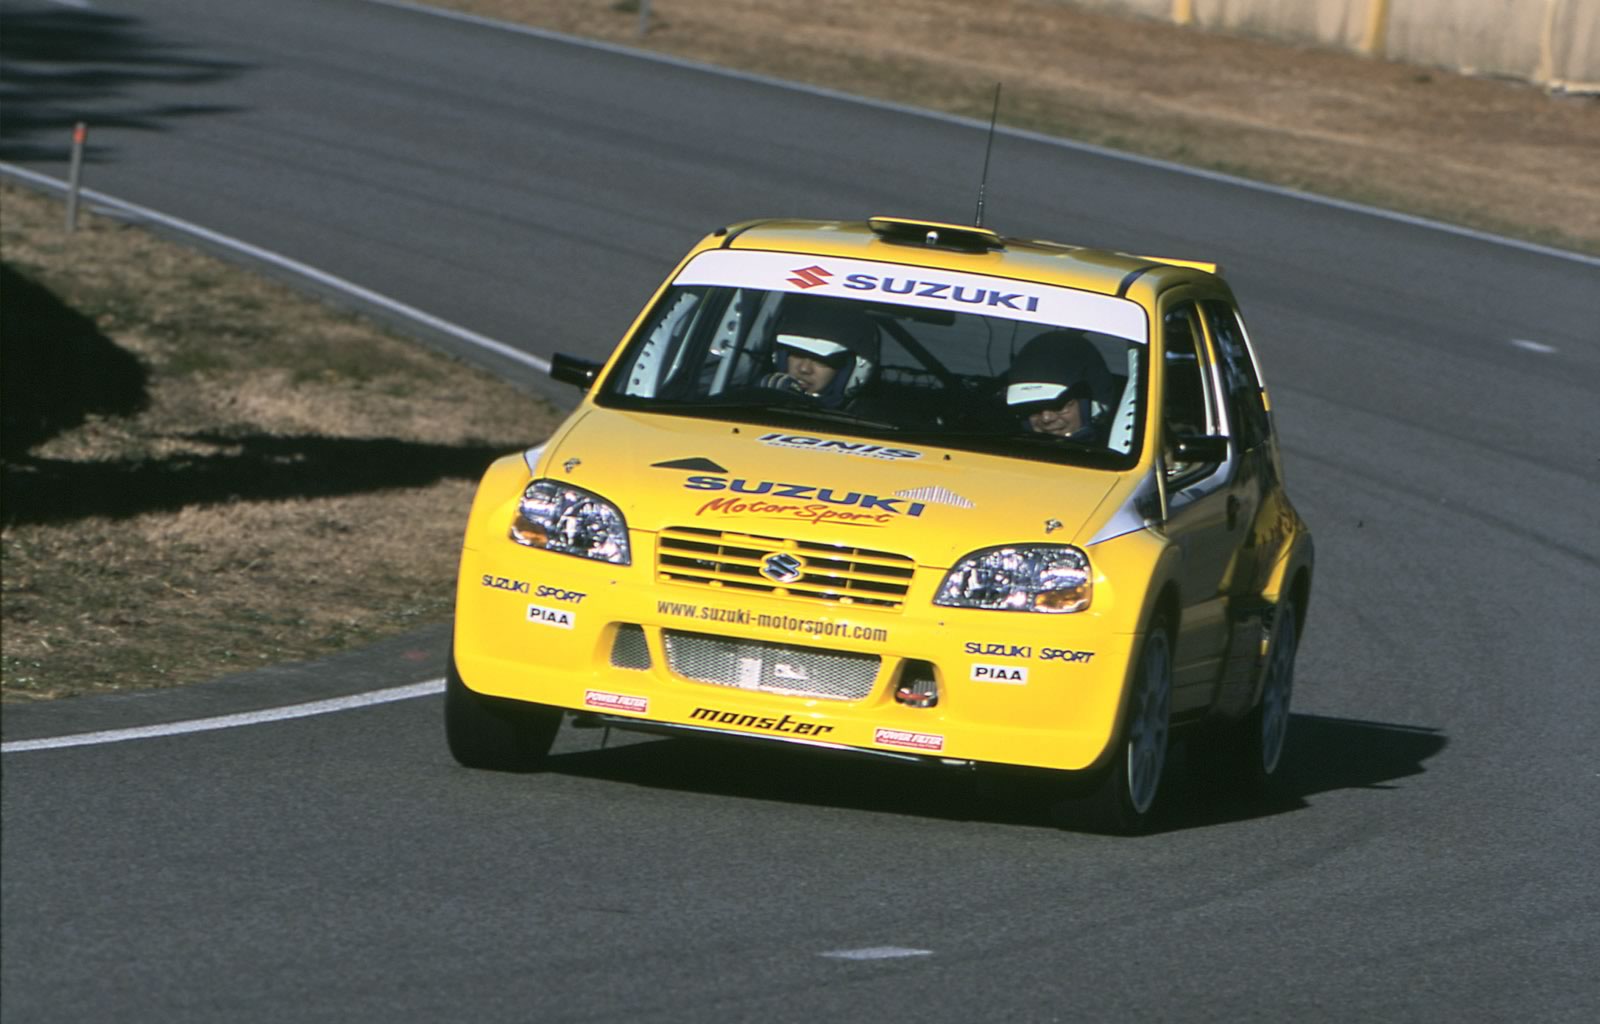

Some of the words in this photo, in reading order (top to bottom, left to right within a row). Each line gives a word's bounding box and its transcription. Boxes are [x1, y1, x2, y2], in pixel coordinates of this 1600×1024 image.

[842, 272, 1039, 312] SUZUKI
[759, 433, 921, 458] IGNIS
[684, 475, 926, 517] SUZUKI
[482, 574, 530, 593] SUZUKI
[535, 585, 587, 604] SPORT
[530, 608, 569, 625] PIAA
[657, 600, 888, 642] www.suzuki-motorsport.com
[965, 642, 1031, 658] SUZUKI
[1040, 648, 1095, 664] SPORT
[975, 667, 1022, 681] PIAA
[586, 691, 620, 704] POWER
[689, 707, 834, 736] monster
[876, 730, 913, 742] POWER
